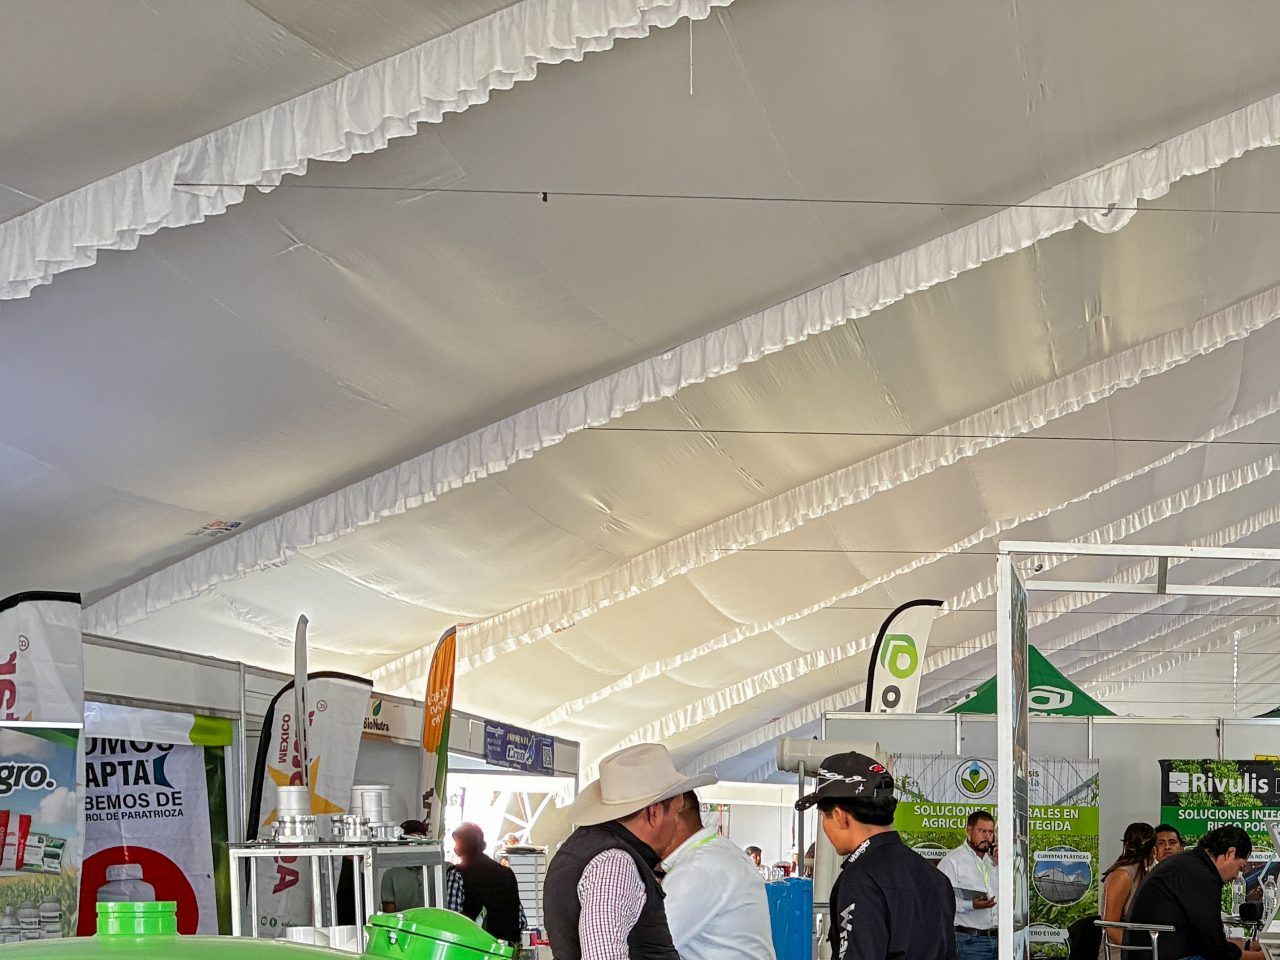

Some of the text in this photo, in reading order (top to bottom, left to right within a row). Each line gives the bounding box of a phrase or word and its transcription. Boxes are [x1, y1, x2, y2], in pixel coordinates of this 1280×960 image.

[363, 717, 390, 731] BioNutra
[278, 713, 291, 763] MEXICO
[1192, 772, 1269, 794] Rivulis
[156, 791, 182, 806] DE
[106, 812, 119, 820] DE
[121, 809, 184, 819] PARATRIOZA
[1064, 809, 1079, 819] EN
[1178, 809, 1249, 820] SOLUCIONES
[921, 817, 1072, 831] AGRICU TEGIDA
[1244, 821, 1267, 832] POR
[1062, 852, 1089, 860] PLÁSTICAS
